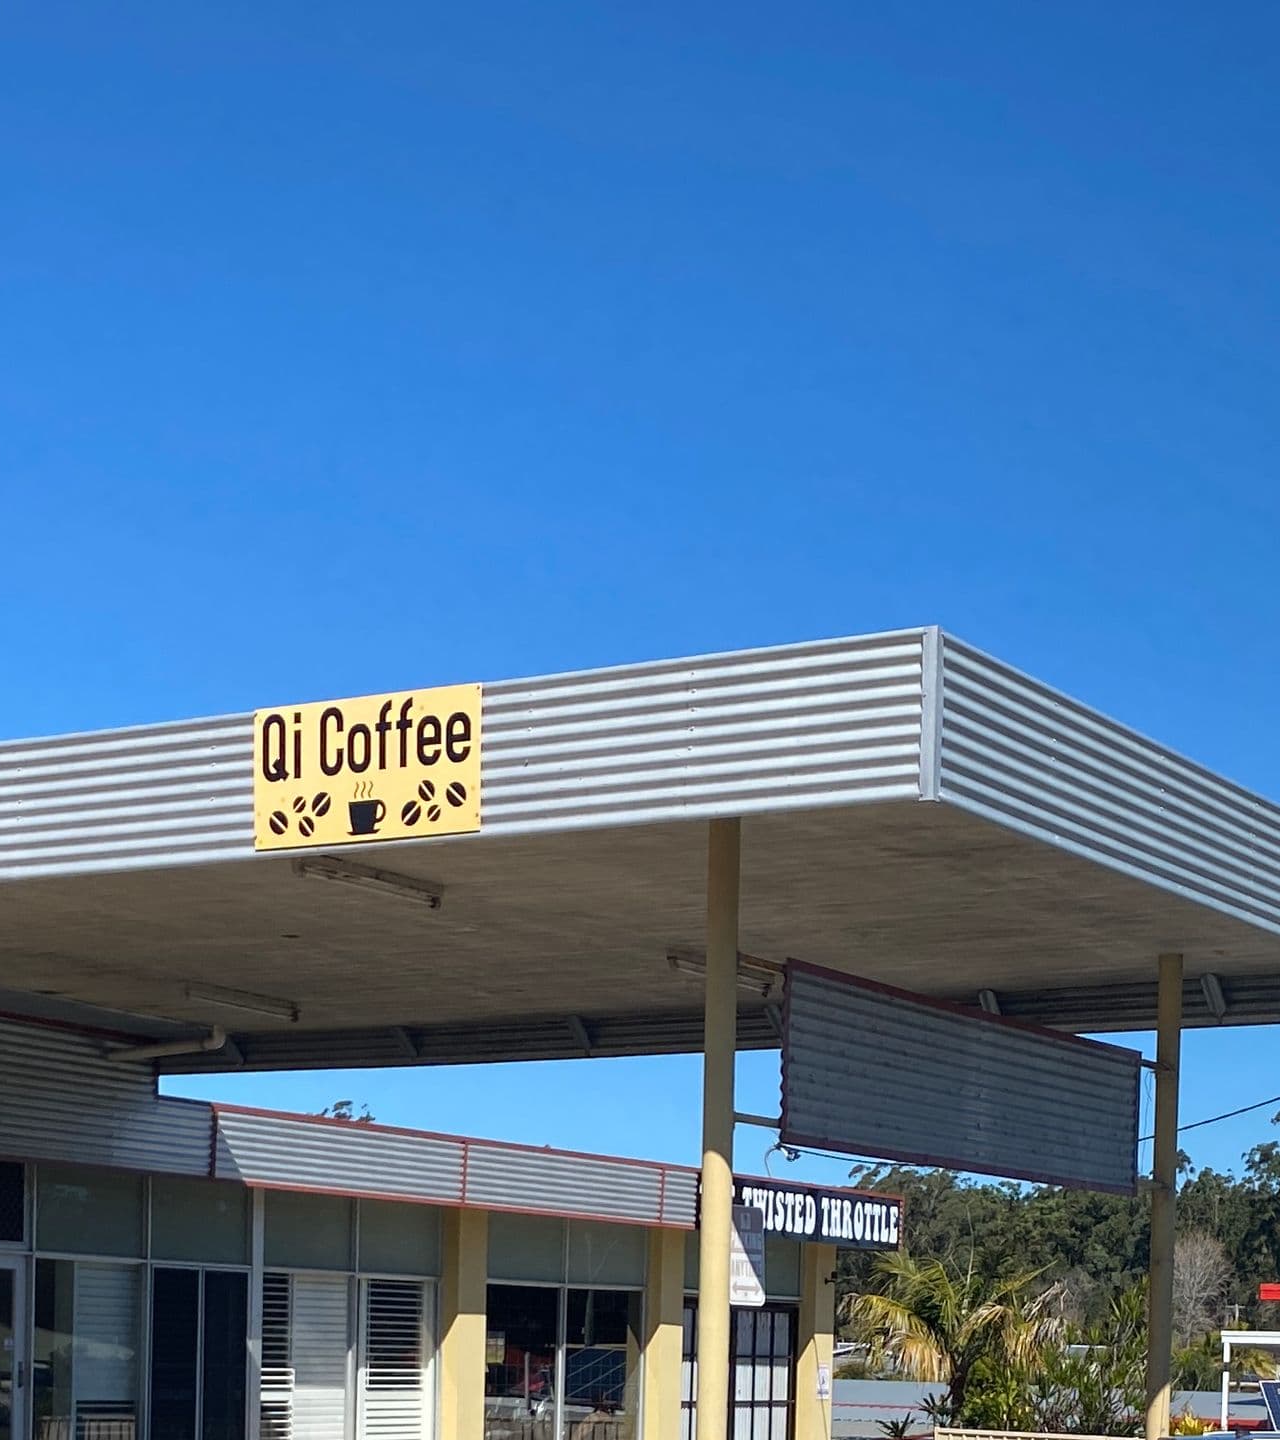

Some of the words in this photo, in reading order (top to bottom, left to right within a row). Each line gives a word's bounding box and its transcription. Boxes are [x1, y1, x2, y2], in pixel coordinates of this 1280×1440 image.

[262, 711, 303, 783] Qi
[319, 697, 472, 777] Coffee
[741, 1186, 817, 1235] TWISTED
[821, 1197, 899, 1244] THROTTLE
